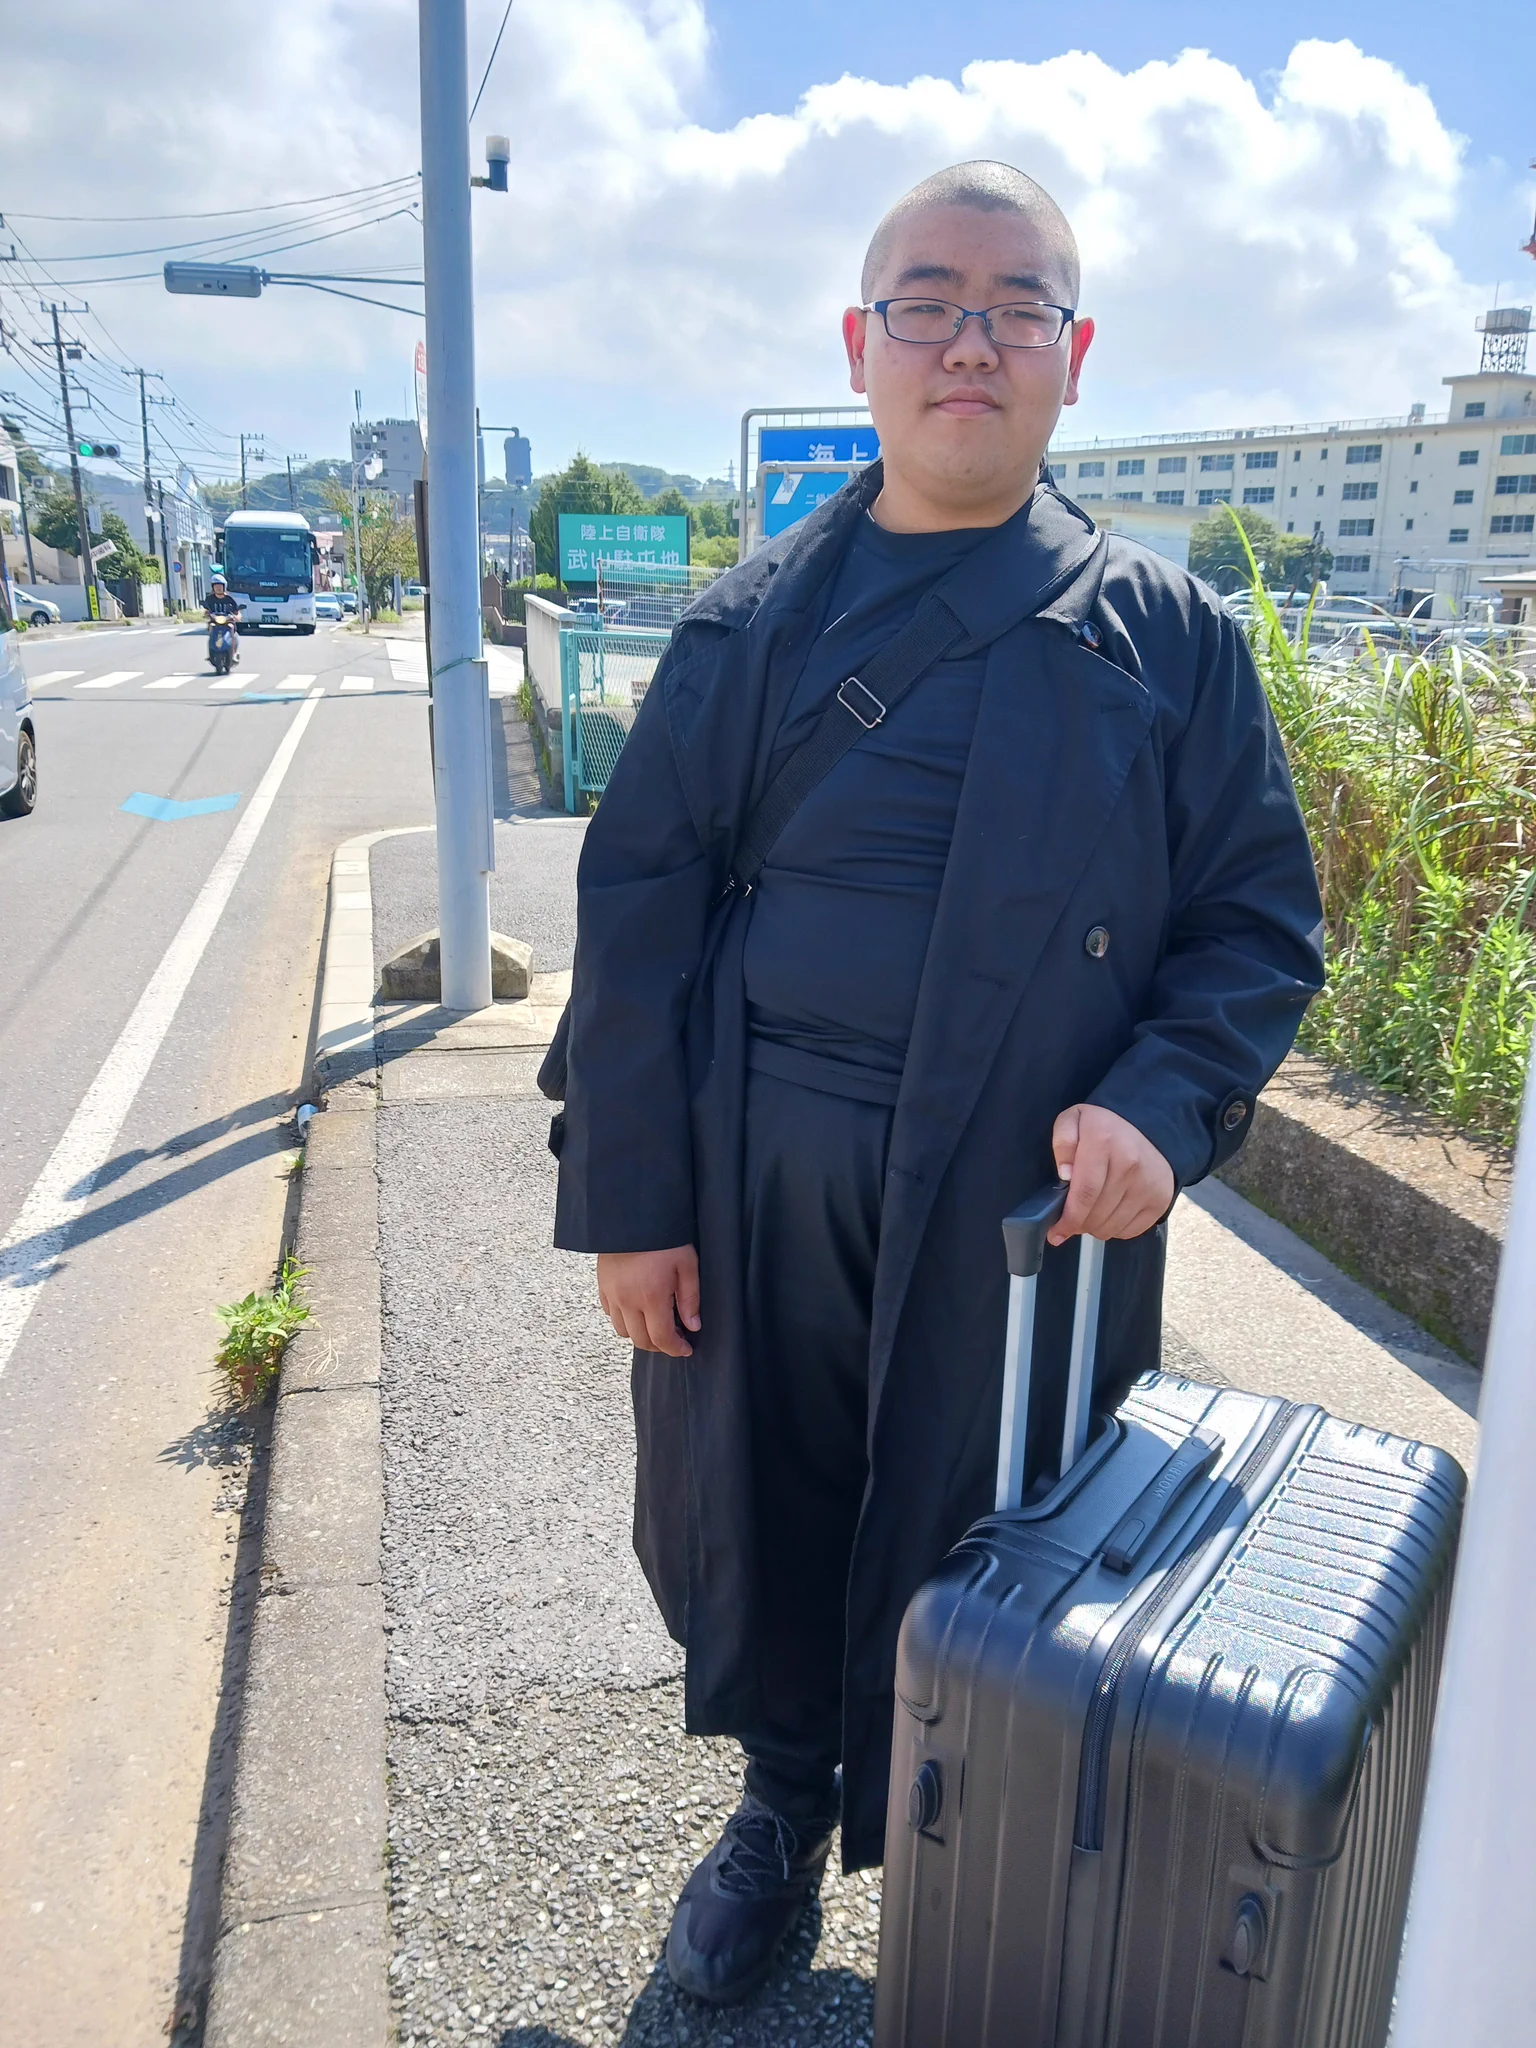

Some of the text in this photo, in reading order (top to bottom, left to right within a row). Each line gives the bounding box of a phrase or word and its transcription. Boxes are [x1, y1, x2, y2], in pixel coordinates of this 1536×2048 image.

[808, 442, 881, 462] 海上
[581, 524, 666, 542] 陸上自衛隊
[567, 548, 680, 570] 武山駐屯地
